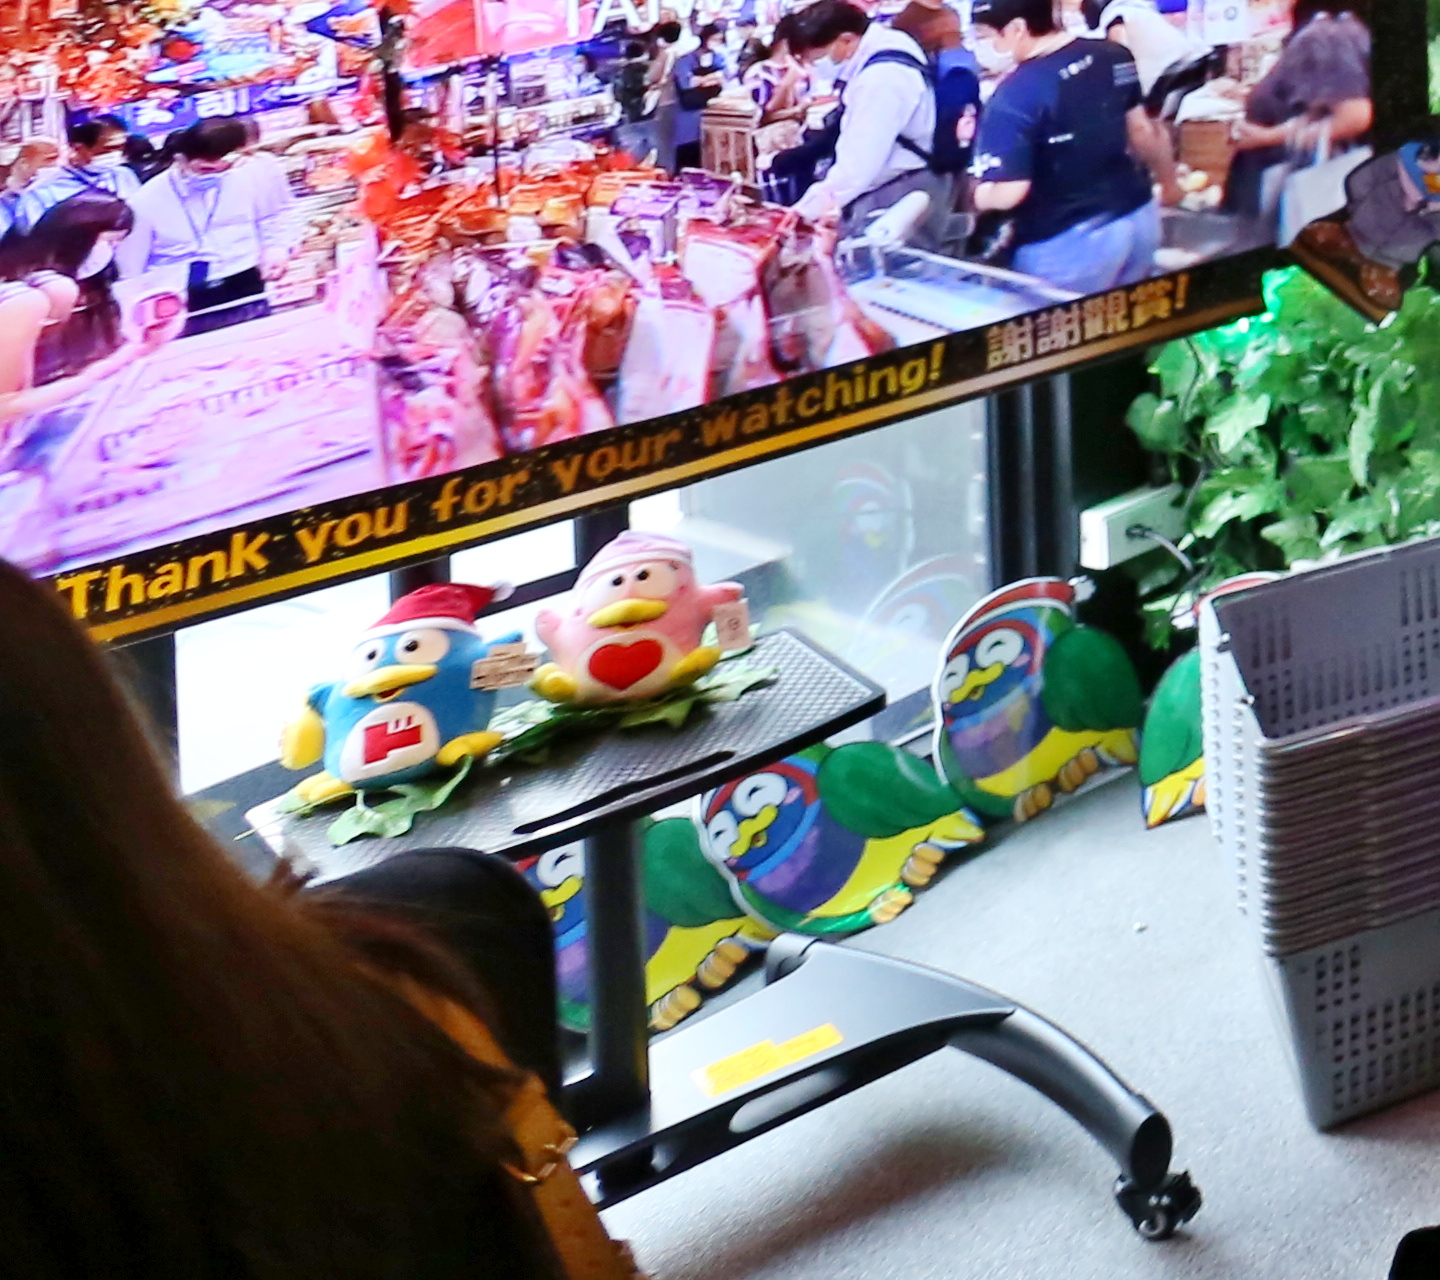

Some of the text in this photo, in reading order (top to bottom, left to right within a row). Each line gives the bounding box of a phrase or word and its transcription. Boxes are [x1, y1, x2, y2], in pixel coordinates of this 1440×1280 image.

[58, 273, 1191, 620] Thank you for your watching! 謝謝觀賞!
